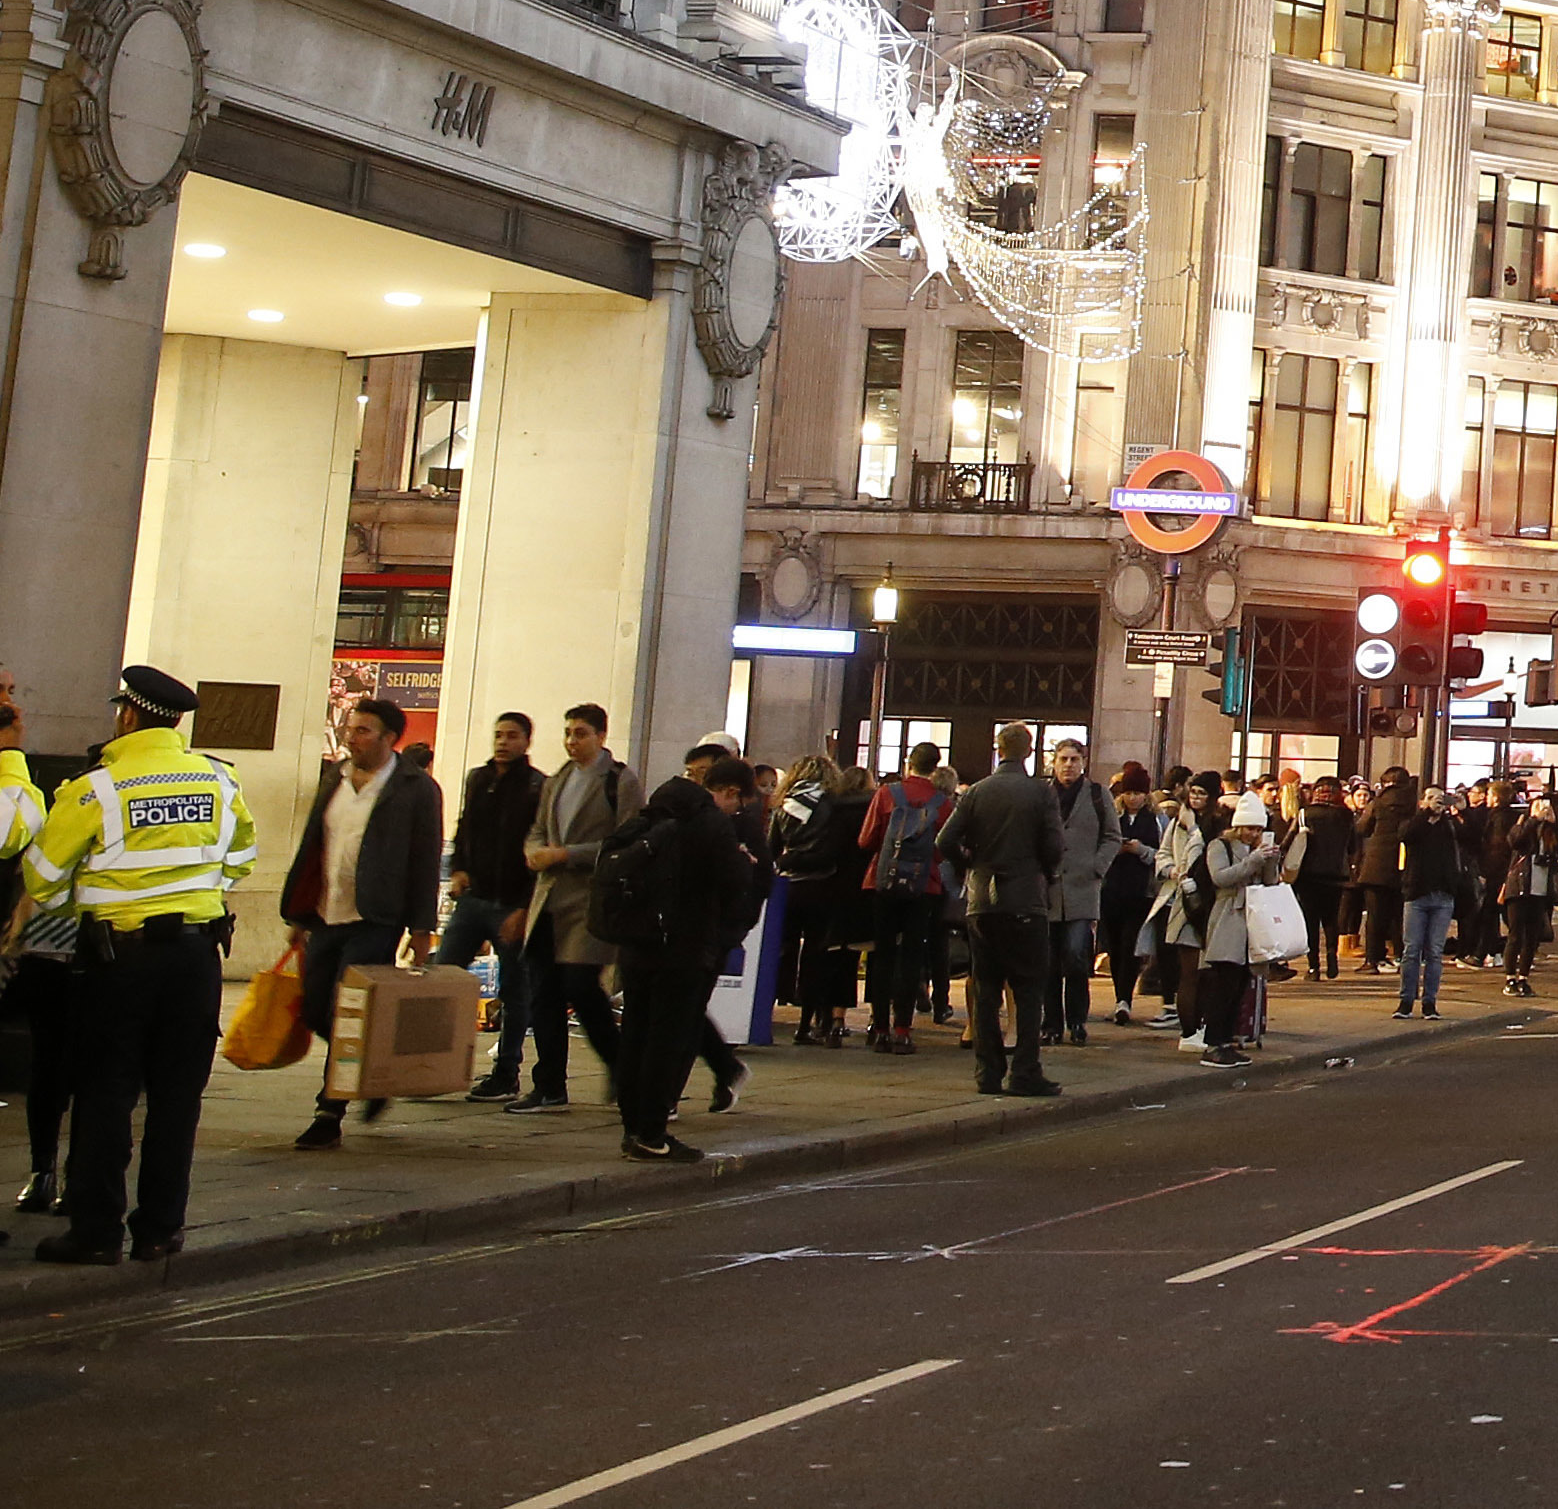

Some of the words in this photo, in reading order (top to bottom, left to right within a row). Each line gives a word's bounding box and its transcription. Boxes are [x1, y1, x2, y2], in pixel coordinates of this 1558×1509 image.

[431, 71, 496, 148] H&M
[1116, 492, 1232, 511] UNDERGROUND
[130, 795, 212, 810] METROPOLITAN
[130, 805, 212, 826] POLICE
